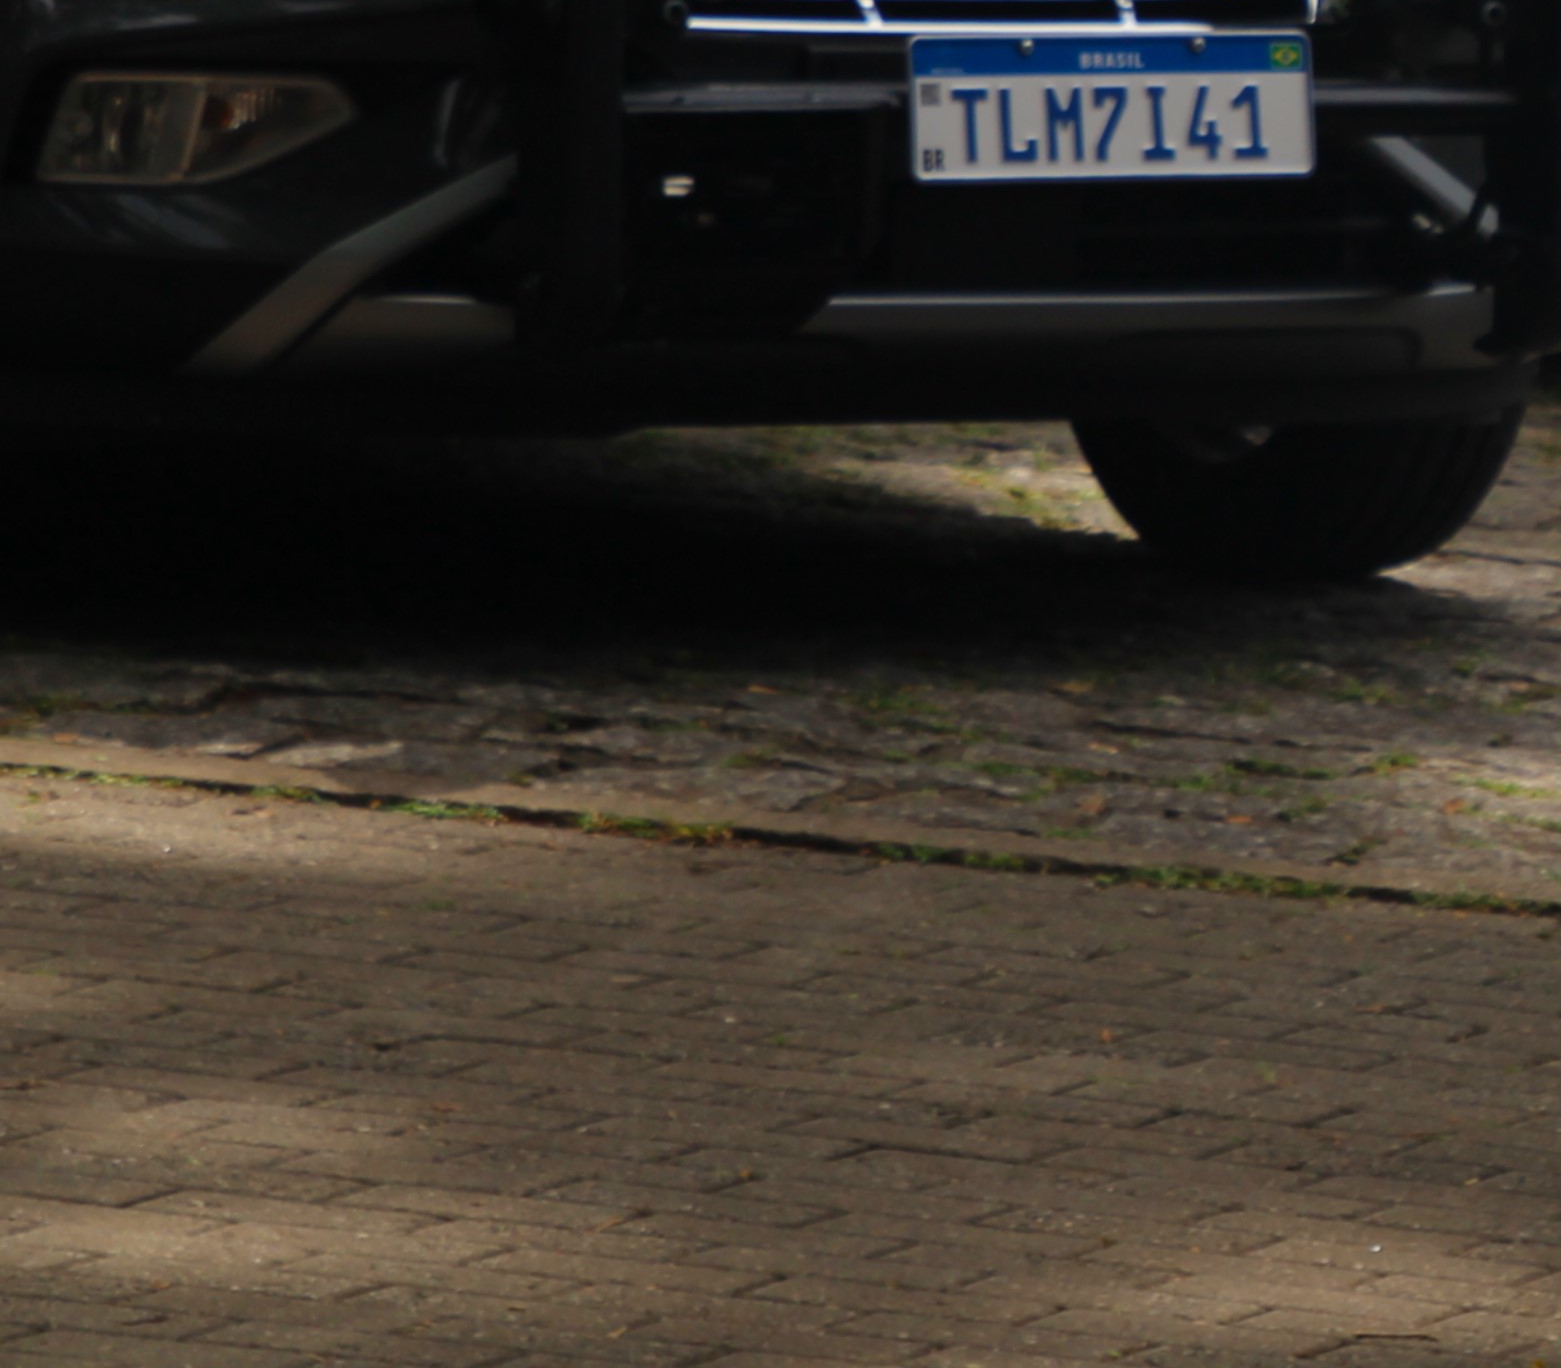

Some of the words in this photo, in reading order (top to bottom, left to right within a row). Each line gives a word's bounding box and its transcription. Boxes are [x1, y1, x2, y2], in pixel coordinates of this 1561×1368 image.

[1079, 52, 1145, 69] BRASIL
[950, 85, 1269, 163] TLM7I41
[922, 148, 945, 172] BR
